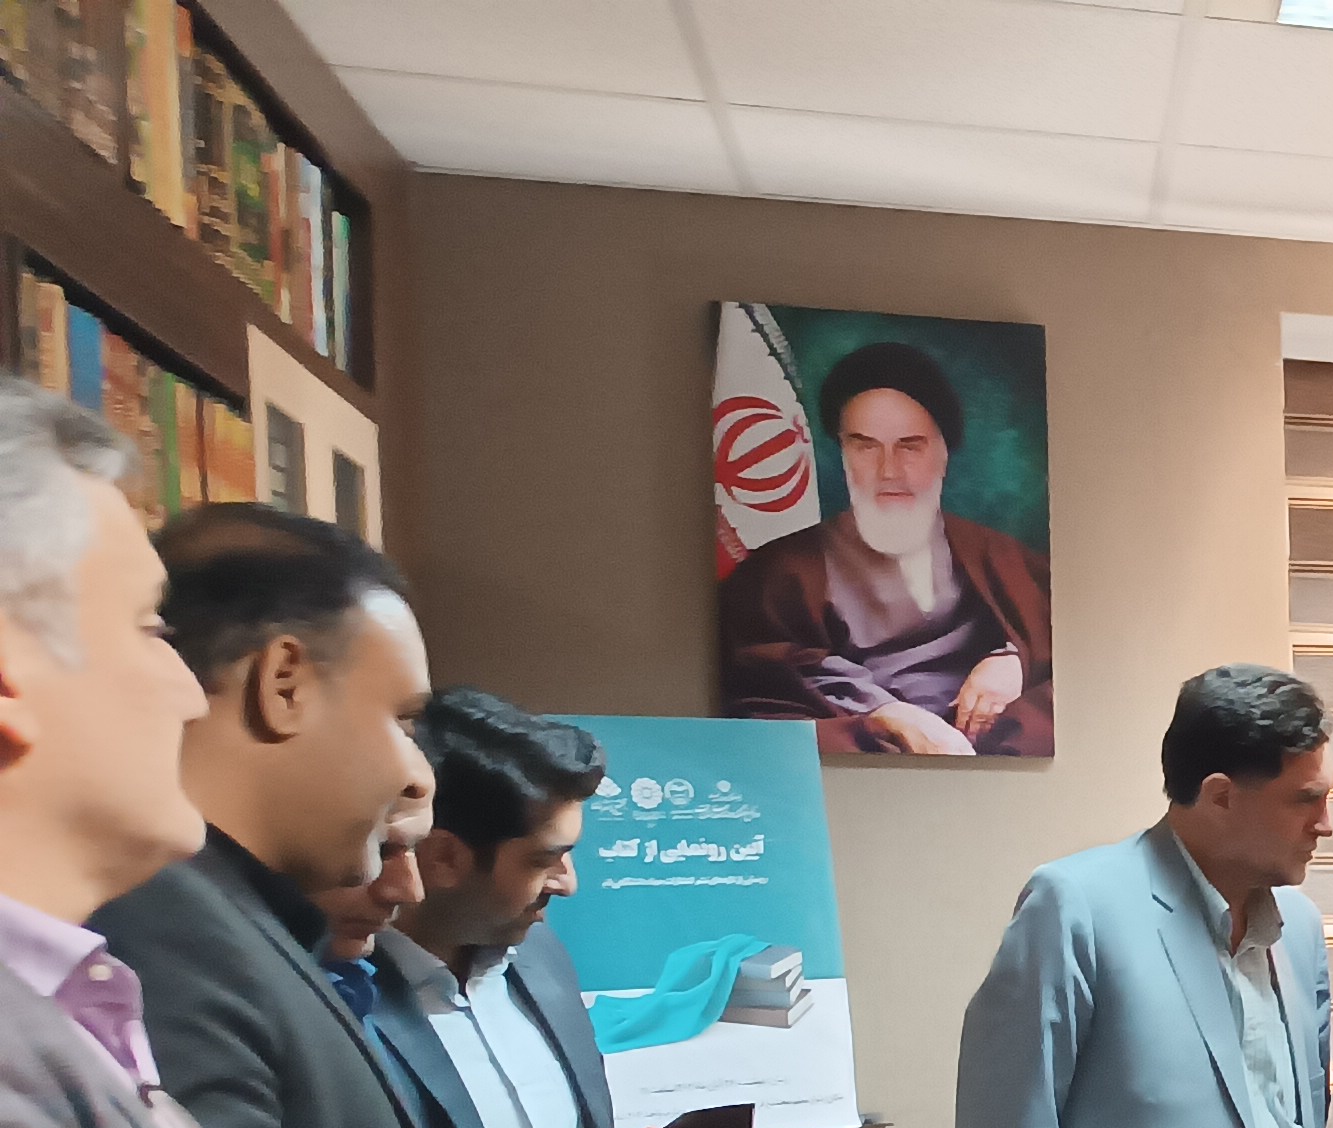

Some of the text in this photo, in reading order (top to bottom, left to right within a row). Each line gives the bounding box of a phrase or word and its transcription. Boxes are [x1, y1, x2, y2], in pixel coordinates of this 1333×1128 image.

[598, 838, 641, 863] کتاب
[643, 839, 658, 863] از
[659, 837, 727, 864] رونمایی
